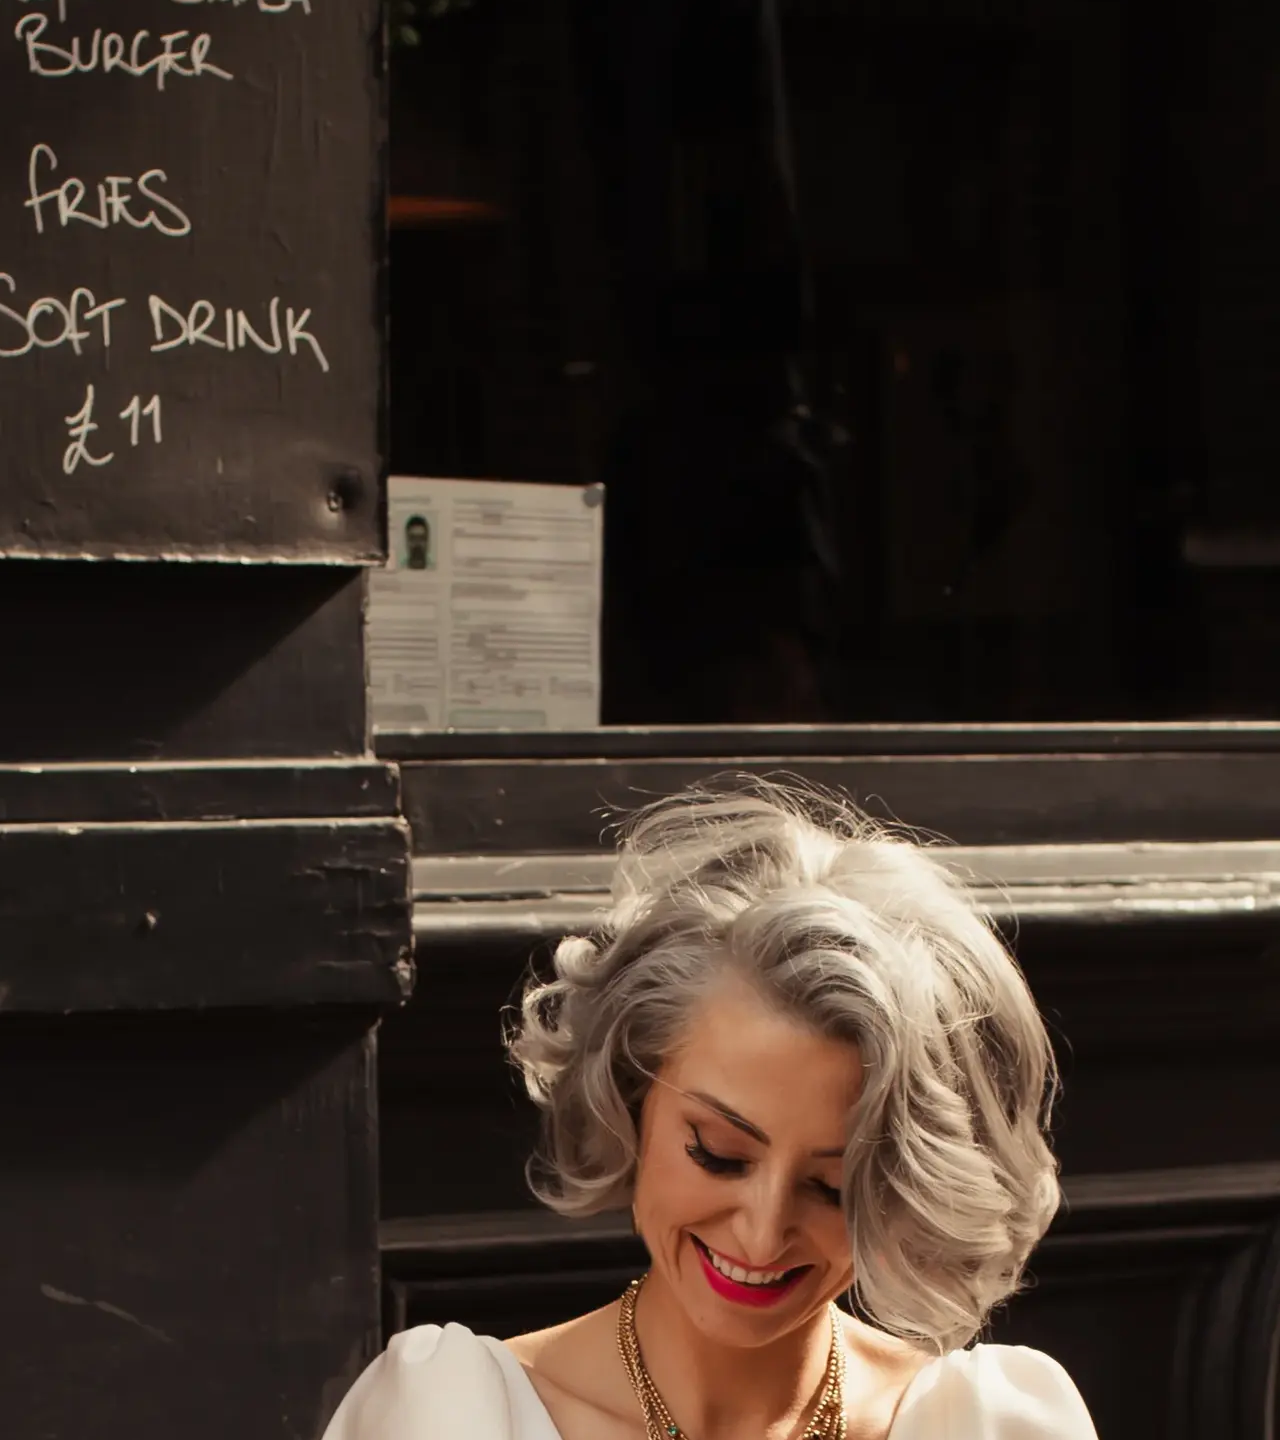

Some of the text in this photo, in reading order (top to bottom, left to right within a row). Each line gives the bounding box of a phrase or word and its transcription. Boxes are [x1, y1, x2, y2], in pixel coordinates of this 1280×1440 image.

[15, 13, 234, 91] BURGER
[24, 143, 192, 237] FRIES
[148, 296, 330, 373] DRINK
